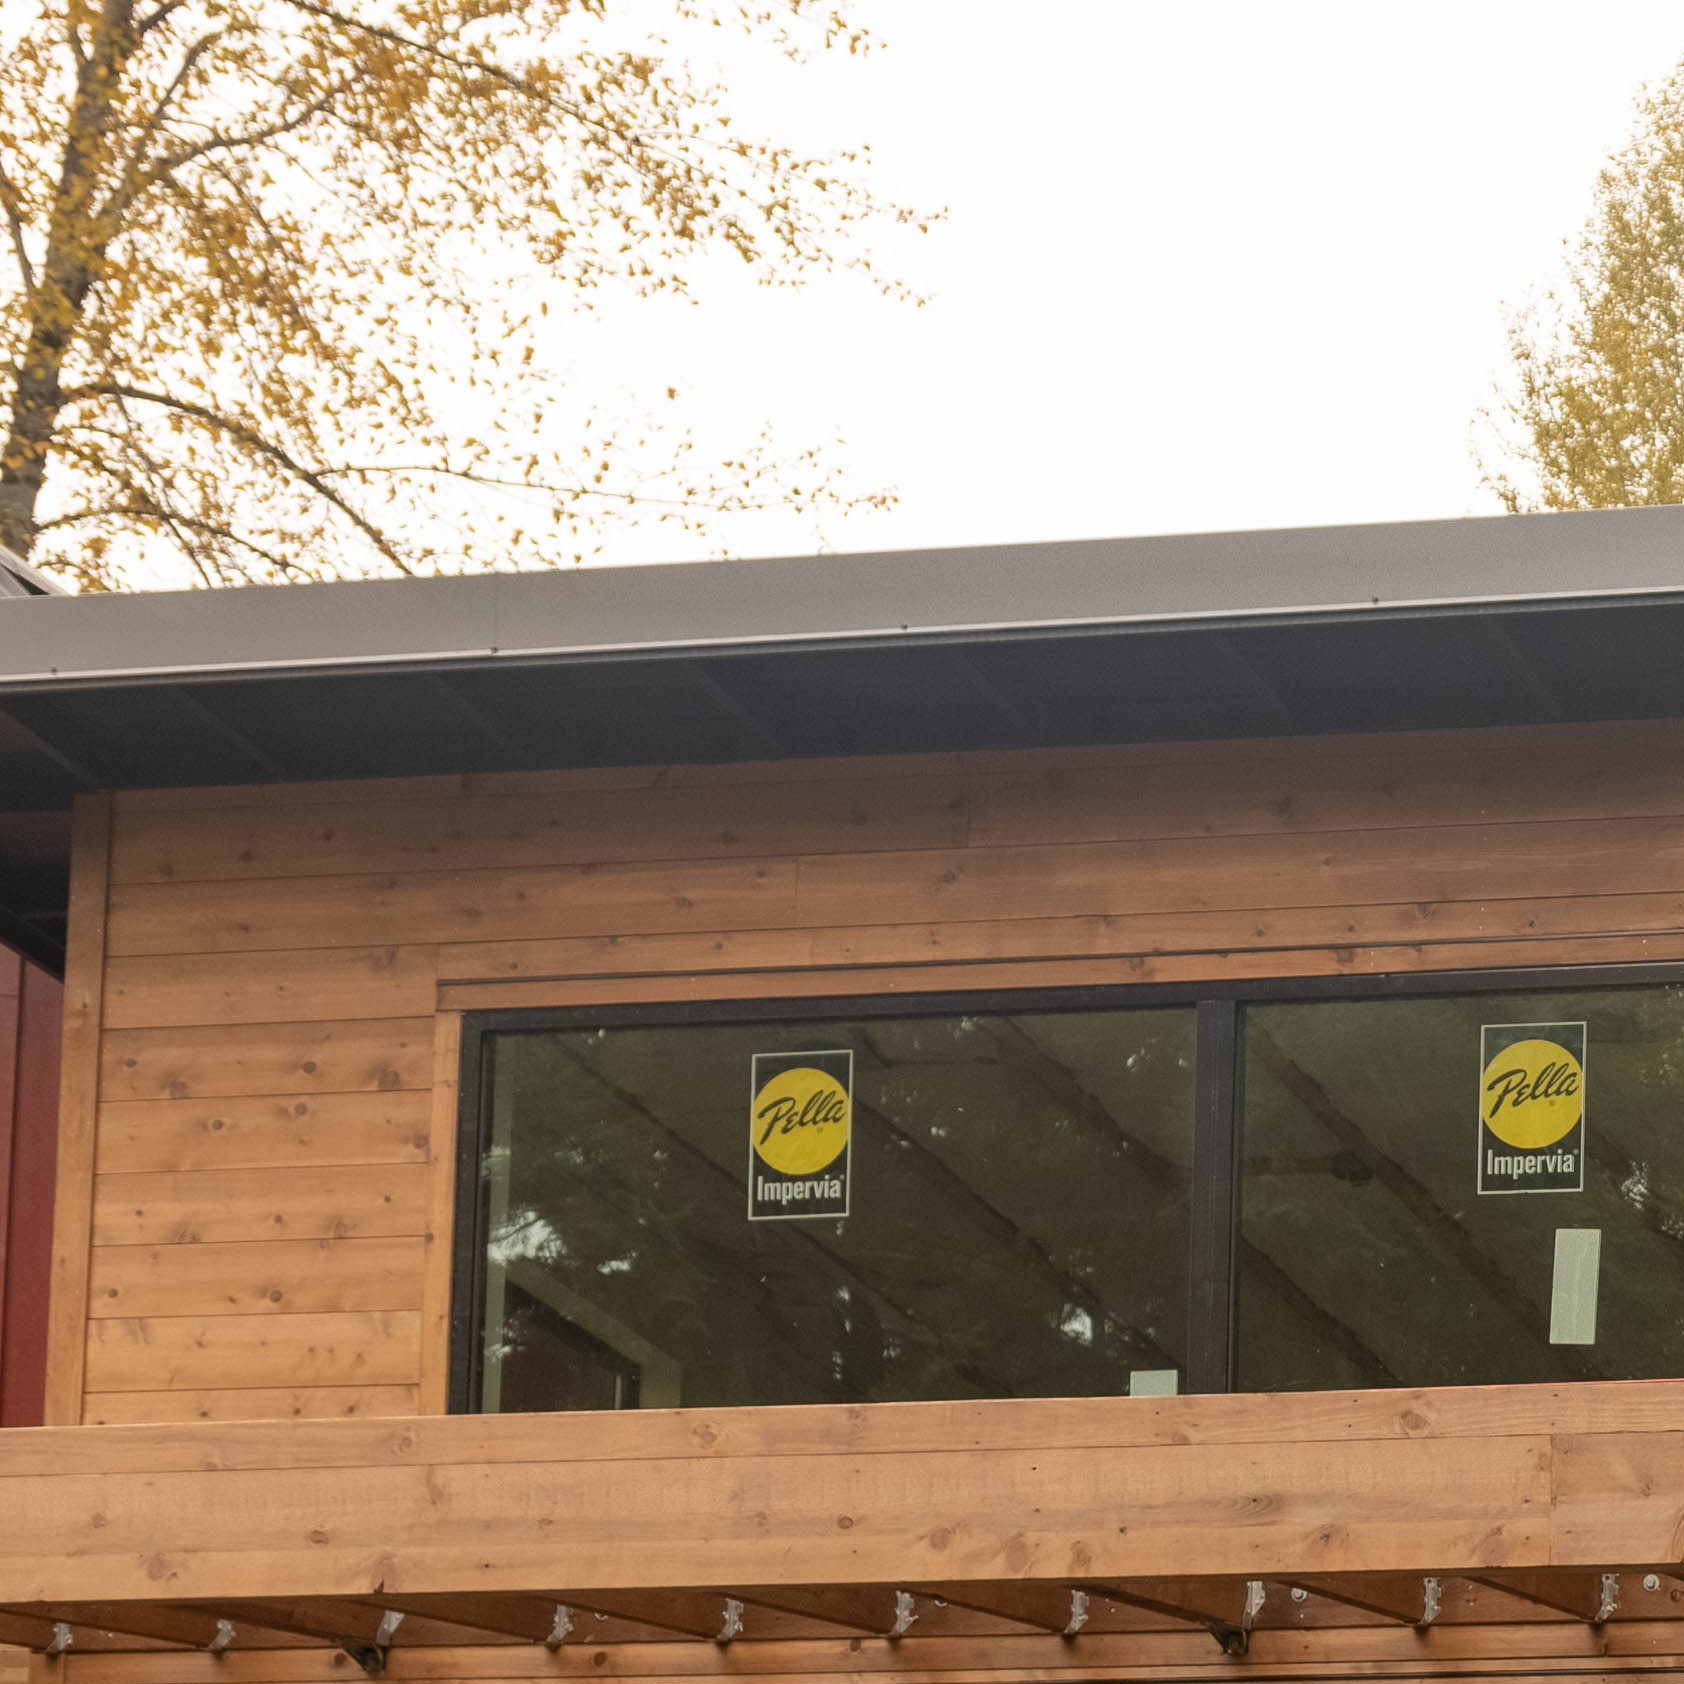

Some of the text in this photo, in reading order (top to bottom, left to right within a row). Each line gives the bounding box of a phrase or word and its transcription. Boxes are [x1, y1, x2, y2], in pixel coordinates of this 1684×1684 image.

[1487, 1062, 1579, 1119] Pella
[757, 1090, 847, 1146] Pella
[1487, 1149, 1575, 1180] Impervia
[757, 1175, 842, 1206] Impervia
